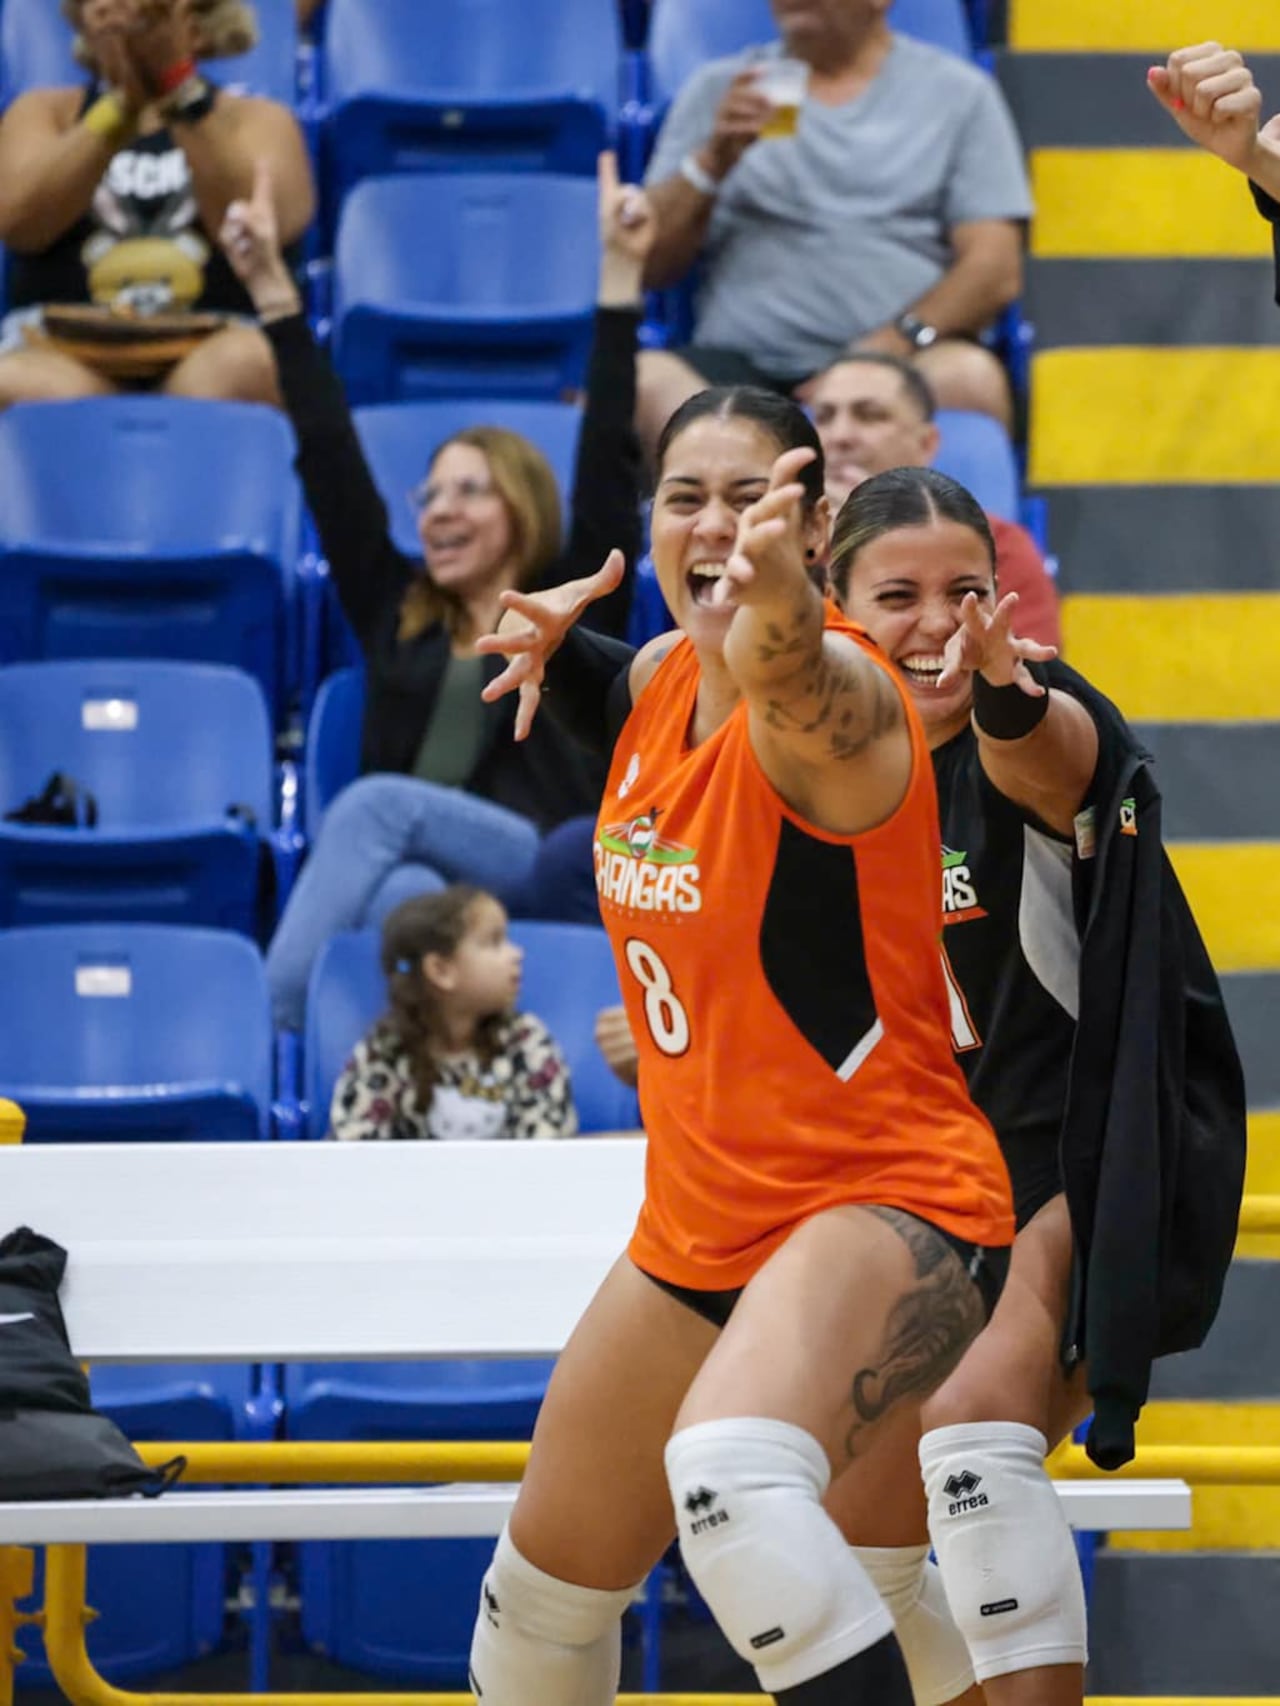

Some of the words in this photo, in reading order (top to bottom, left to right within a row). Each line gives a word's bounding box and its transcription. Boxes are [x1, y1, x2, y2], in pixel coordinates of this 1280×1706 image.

[593, 841, 702, 913] HANGAS
[624, 936, 692, 1059] 8
[690, 1508, 730, 1536] errea
[948, 1492, 989, 1516] errea
